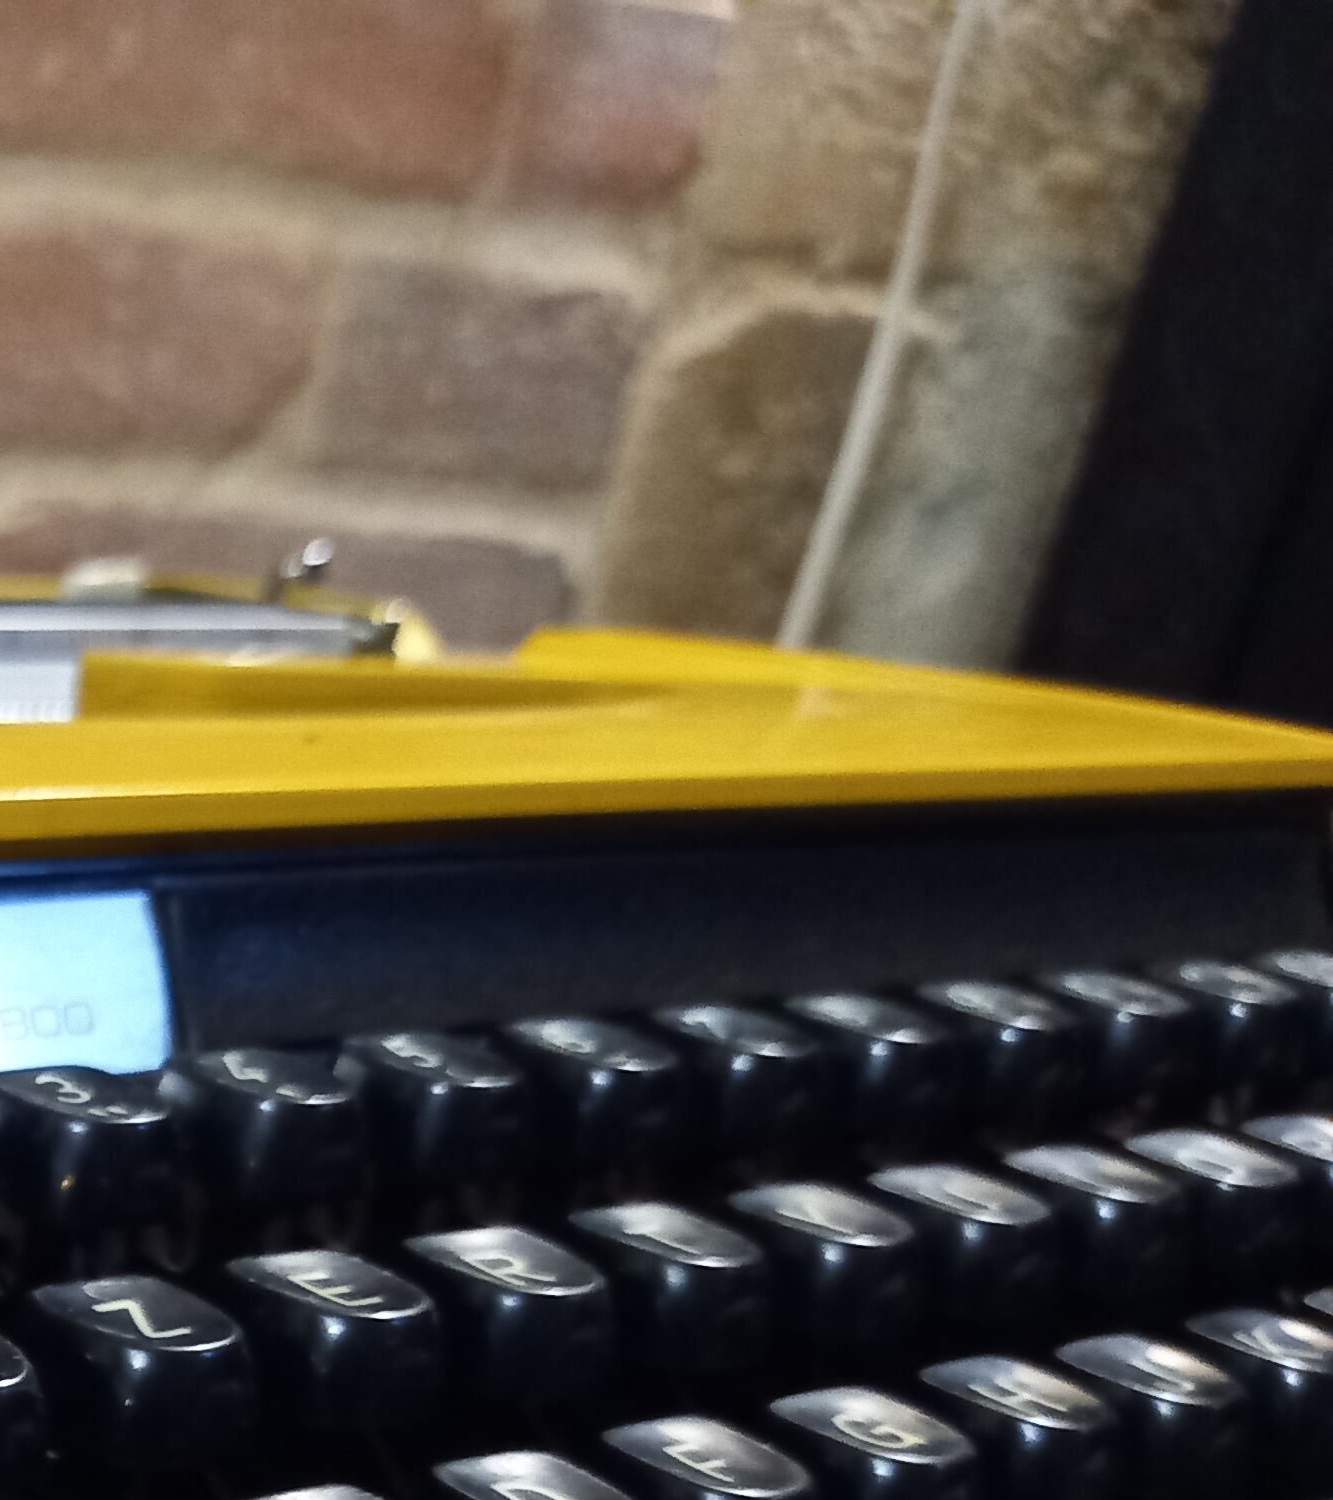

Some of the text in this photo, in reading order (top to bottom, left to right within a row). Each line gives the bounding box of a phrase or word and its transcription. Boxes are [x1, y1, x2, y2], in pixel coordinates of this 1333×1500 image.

[460, 1254, 558, 1286] R
[285, 1273, 383, 1307] E
[91, 1299, 193, 1339] Z
